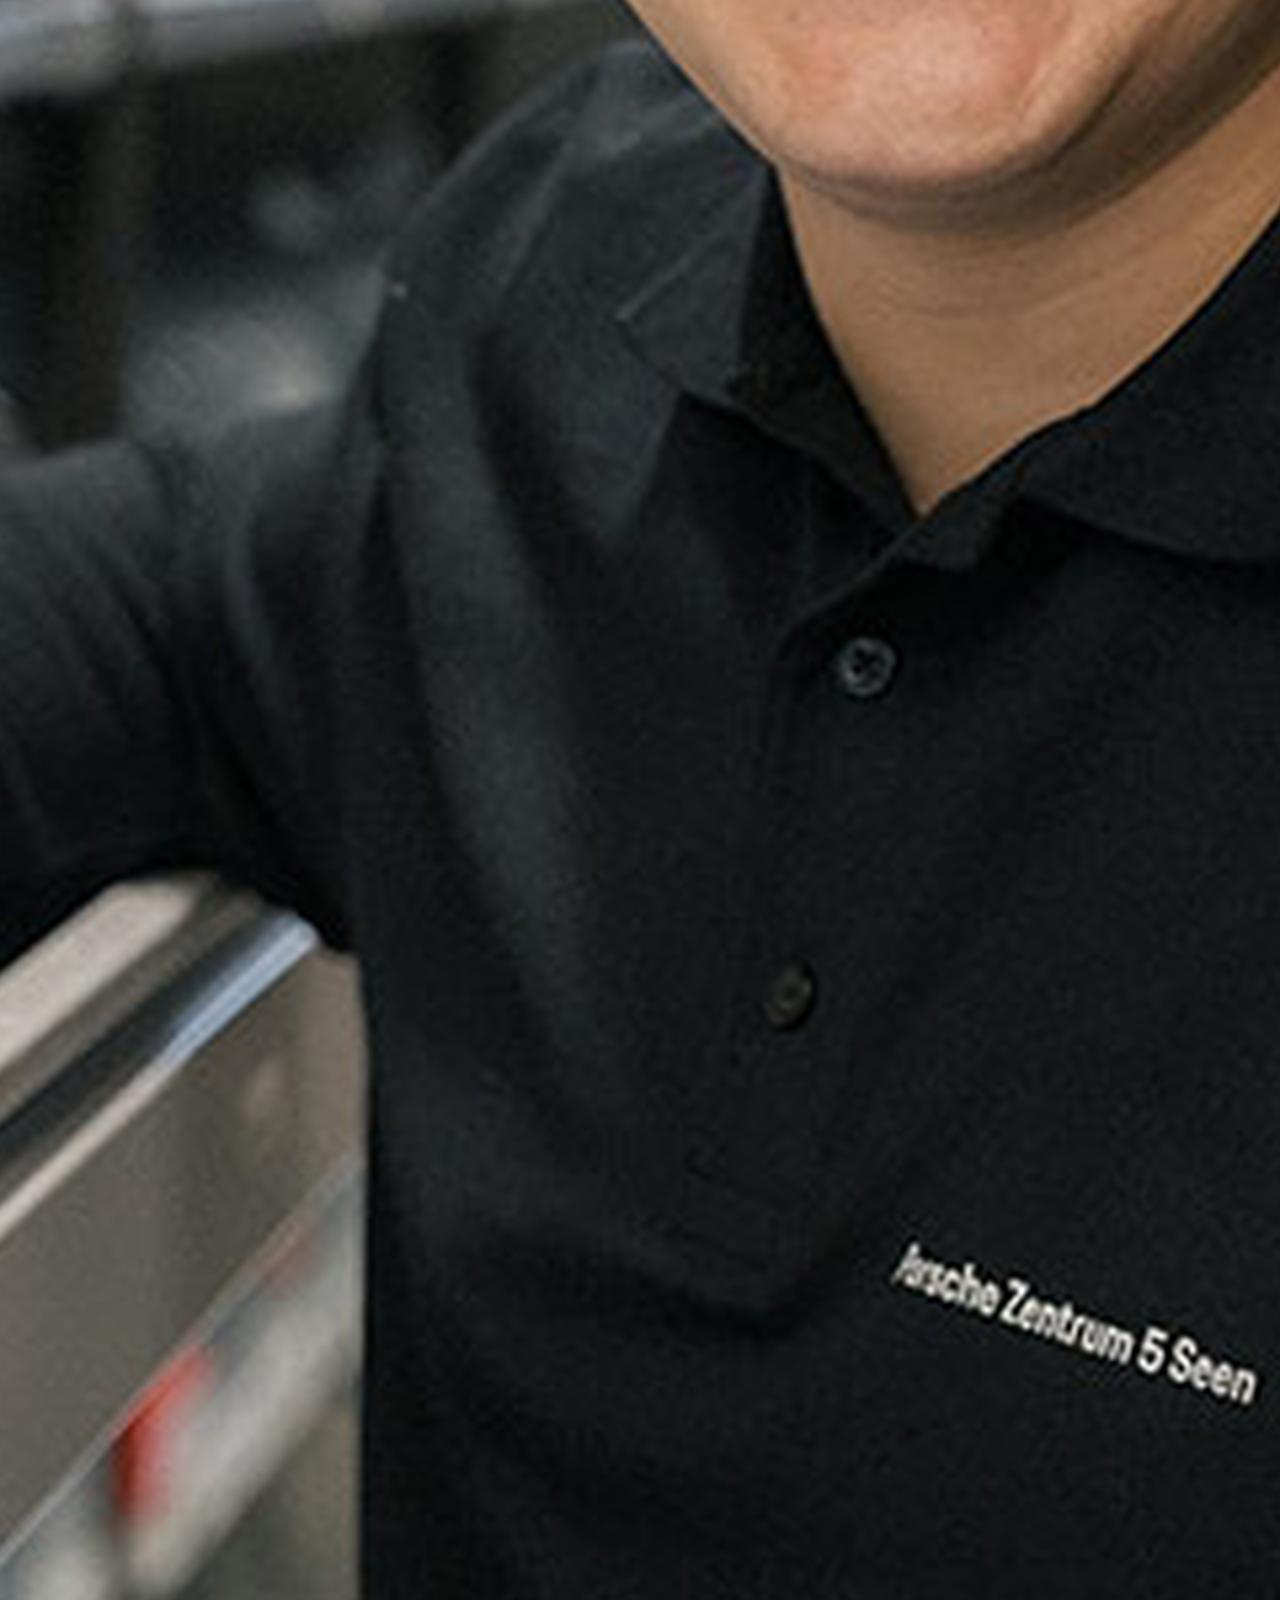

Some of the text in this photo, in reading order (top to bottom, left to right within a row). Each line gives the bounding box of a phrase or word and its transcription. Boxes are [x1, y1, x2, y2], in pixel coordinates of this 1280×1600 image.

[999, 1277, 1136, 1365] Zentrum
[1136, 1325, 1169, 1375] 5
[1167, 1335, 1257, 1405] Seen
